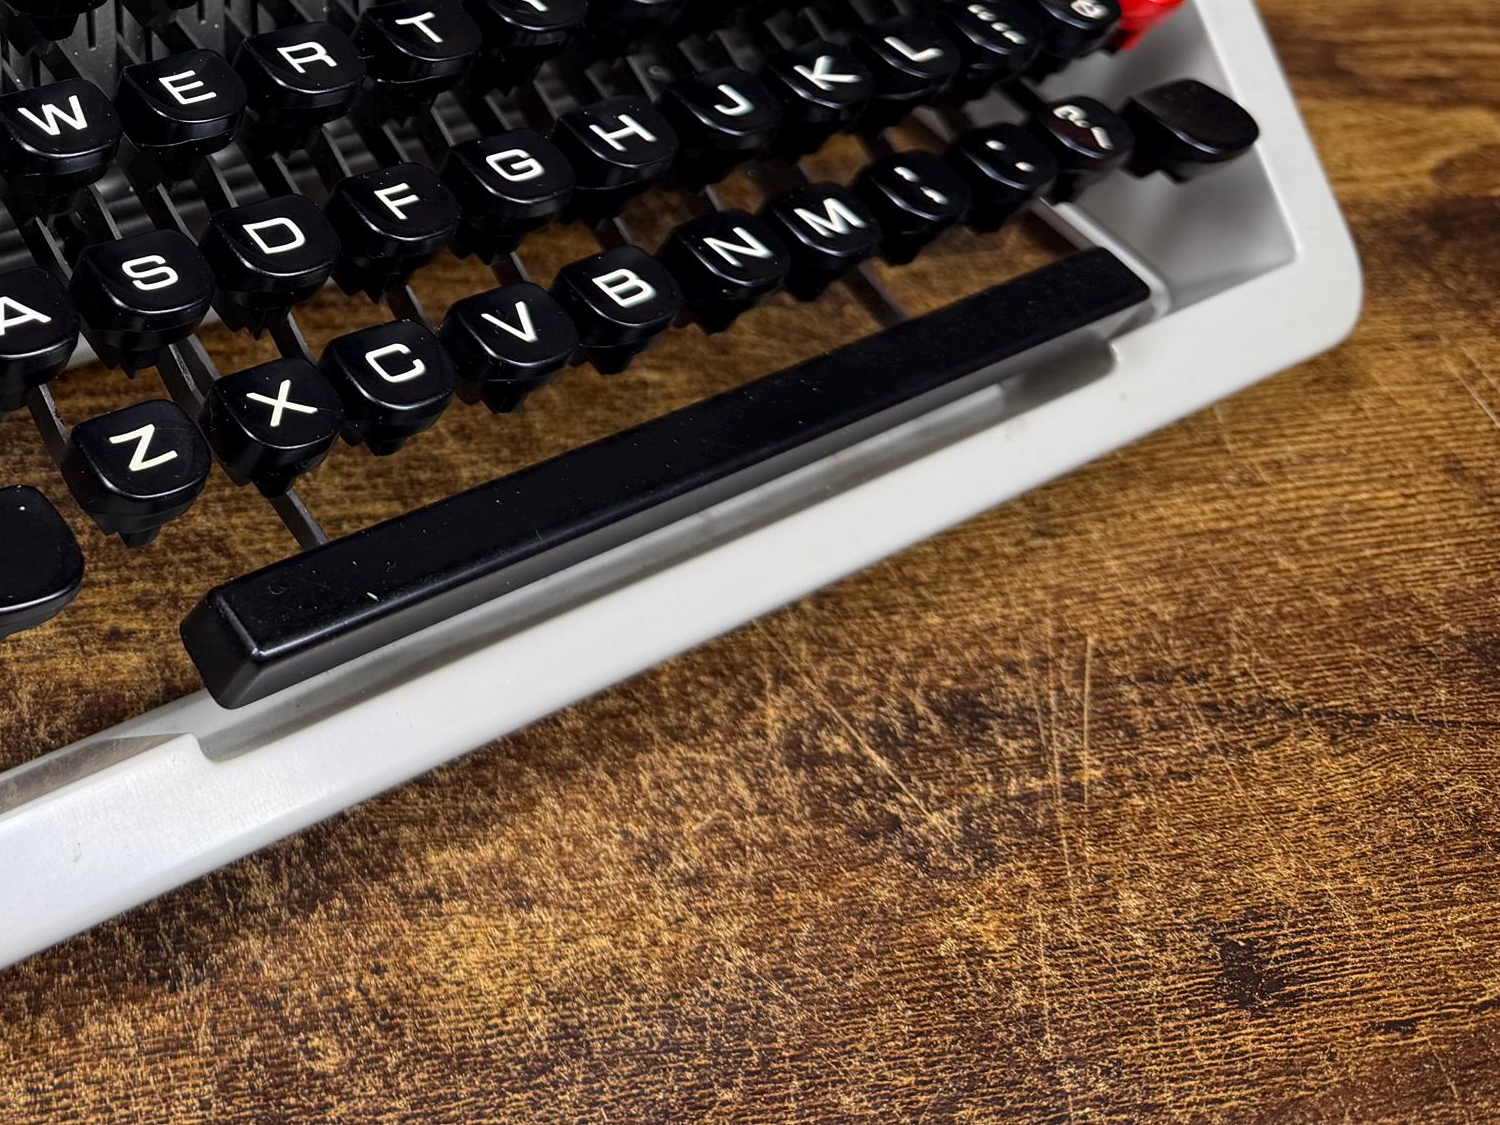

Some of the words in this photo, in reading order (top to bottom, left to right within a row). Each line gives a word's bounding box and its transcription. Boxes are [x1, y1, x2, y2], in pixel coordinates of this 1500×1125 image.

[395, 11, 443, 43] T
[276, 41, 338, 74] R
[884, 36, 944, 63] L
[158, 69, 217, 105] E
[794, 55, 861, 91] K
[17, 94, 88, 136] W
[714, 84, 754, 116] J
[589, 114, 657, 151] H
[485, 148, 545, 183] G
[373, 182, 419, 220] F
[793, 197, 866, 238] M
[242, 217, 306, 255] D
[702, 226, 774, 267] N
[121, 254, 179, 291] S
[590, 268, 656, 308] B
[479, 301, 538, 344] V
[364, 343, 426, 383] C
[243, 377, 319, 427] X
[108, 423, 178, 472] Z
